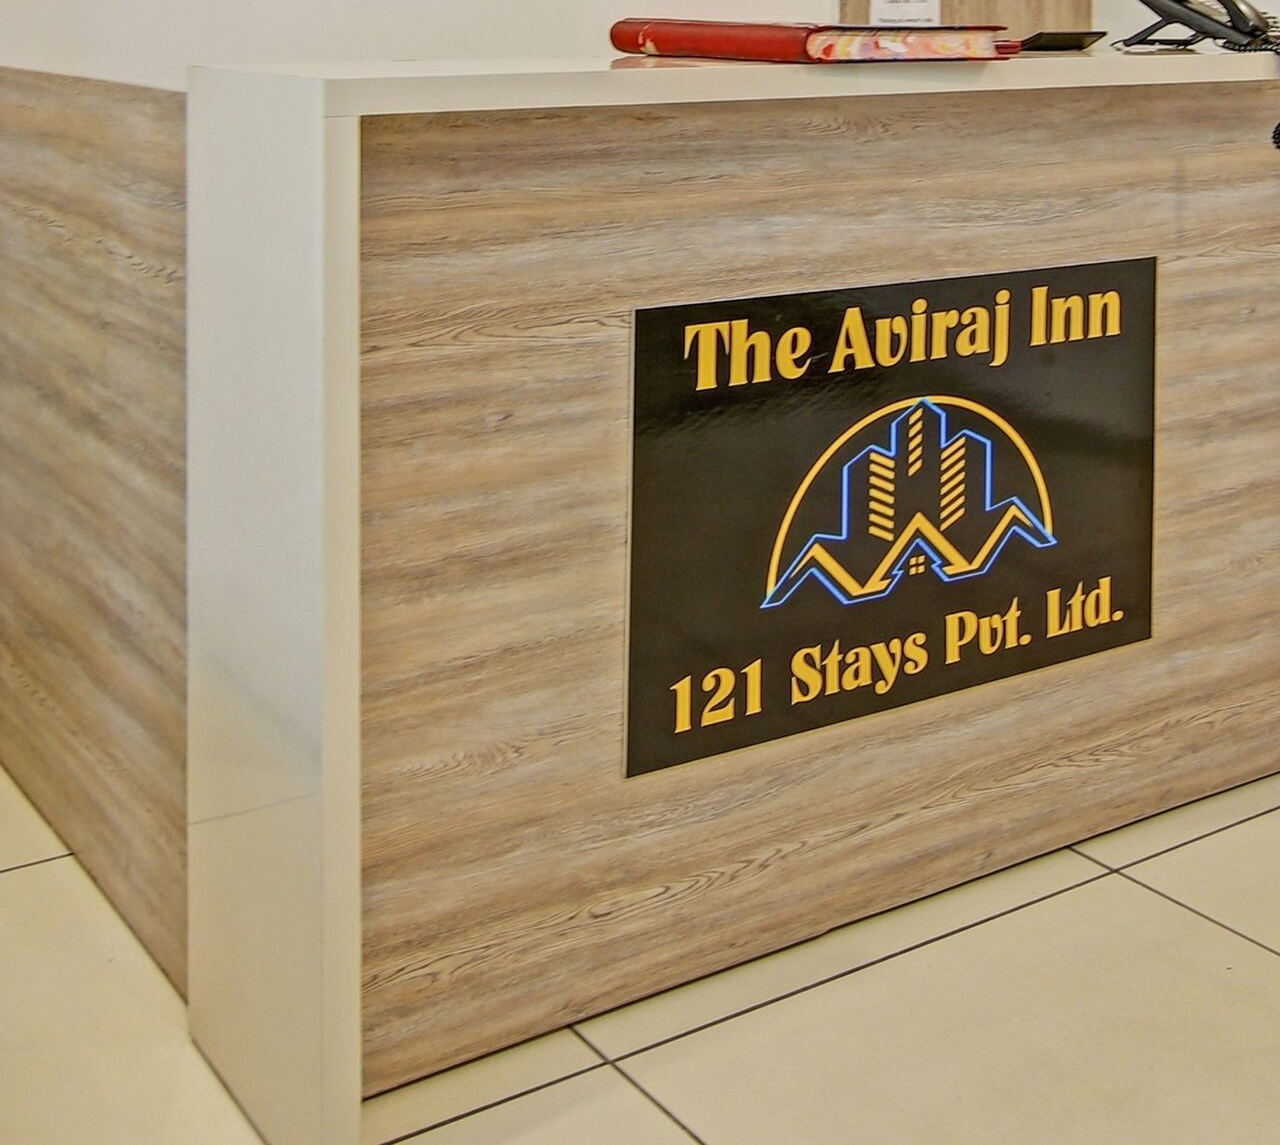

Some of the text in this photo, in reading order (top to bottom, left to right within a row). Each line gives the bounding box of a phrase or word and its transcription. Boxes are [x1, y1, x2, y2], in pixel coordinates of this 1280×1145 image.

[683, 285, 1122, 391] The Aviraj Inn
[669, 575, 1125, 734] 121 Stays Pvt. Ltd.
